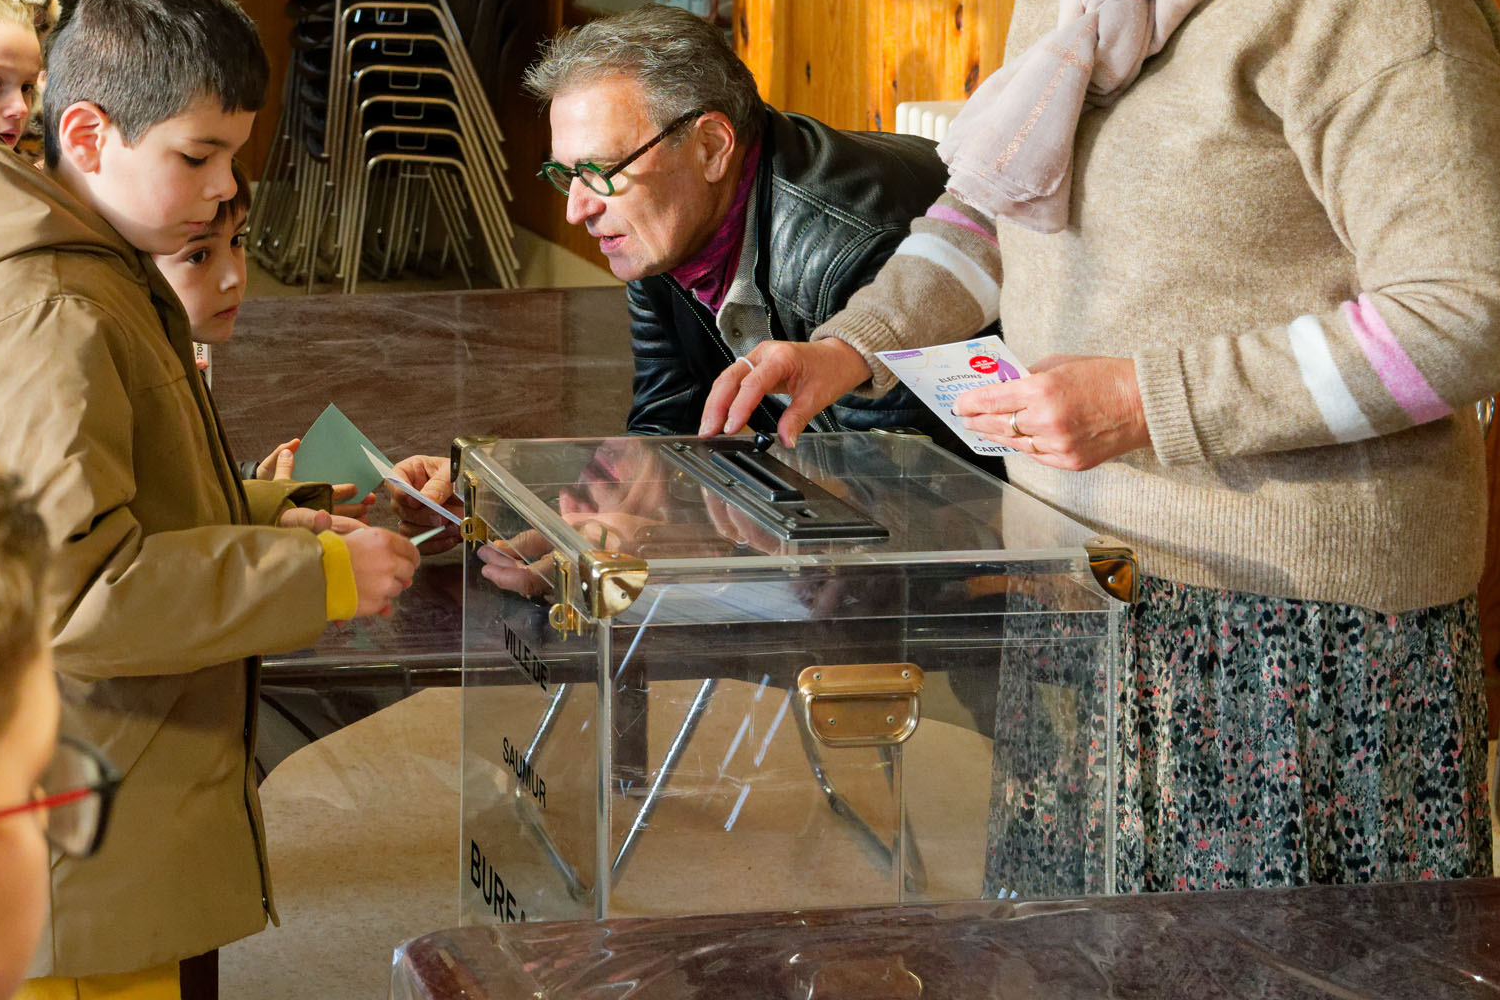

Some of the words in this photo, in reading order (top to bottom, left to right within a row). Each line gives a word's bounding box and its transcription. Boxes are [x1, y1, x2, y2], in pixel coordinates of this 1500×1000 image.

[503, 623, 530, 674] VILLE
[503, 736, 546, 809] SAUMUR
[471, 839, 525, 923] BURE
